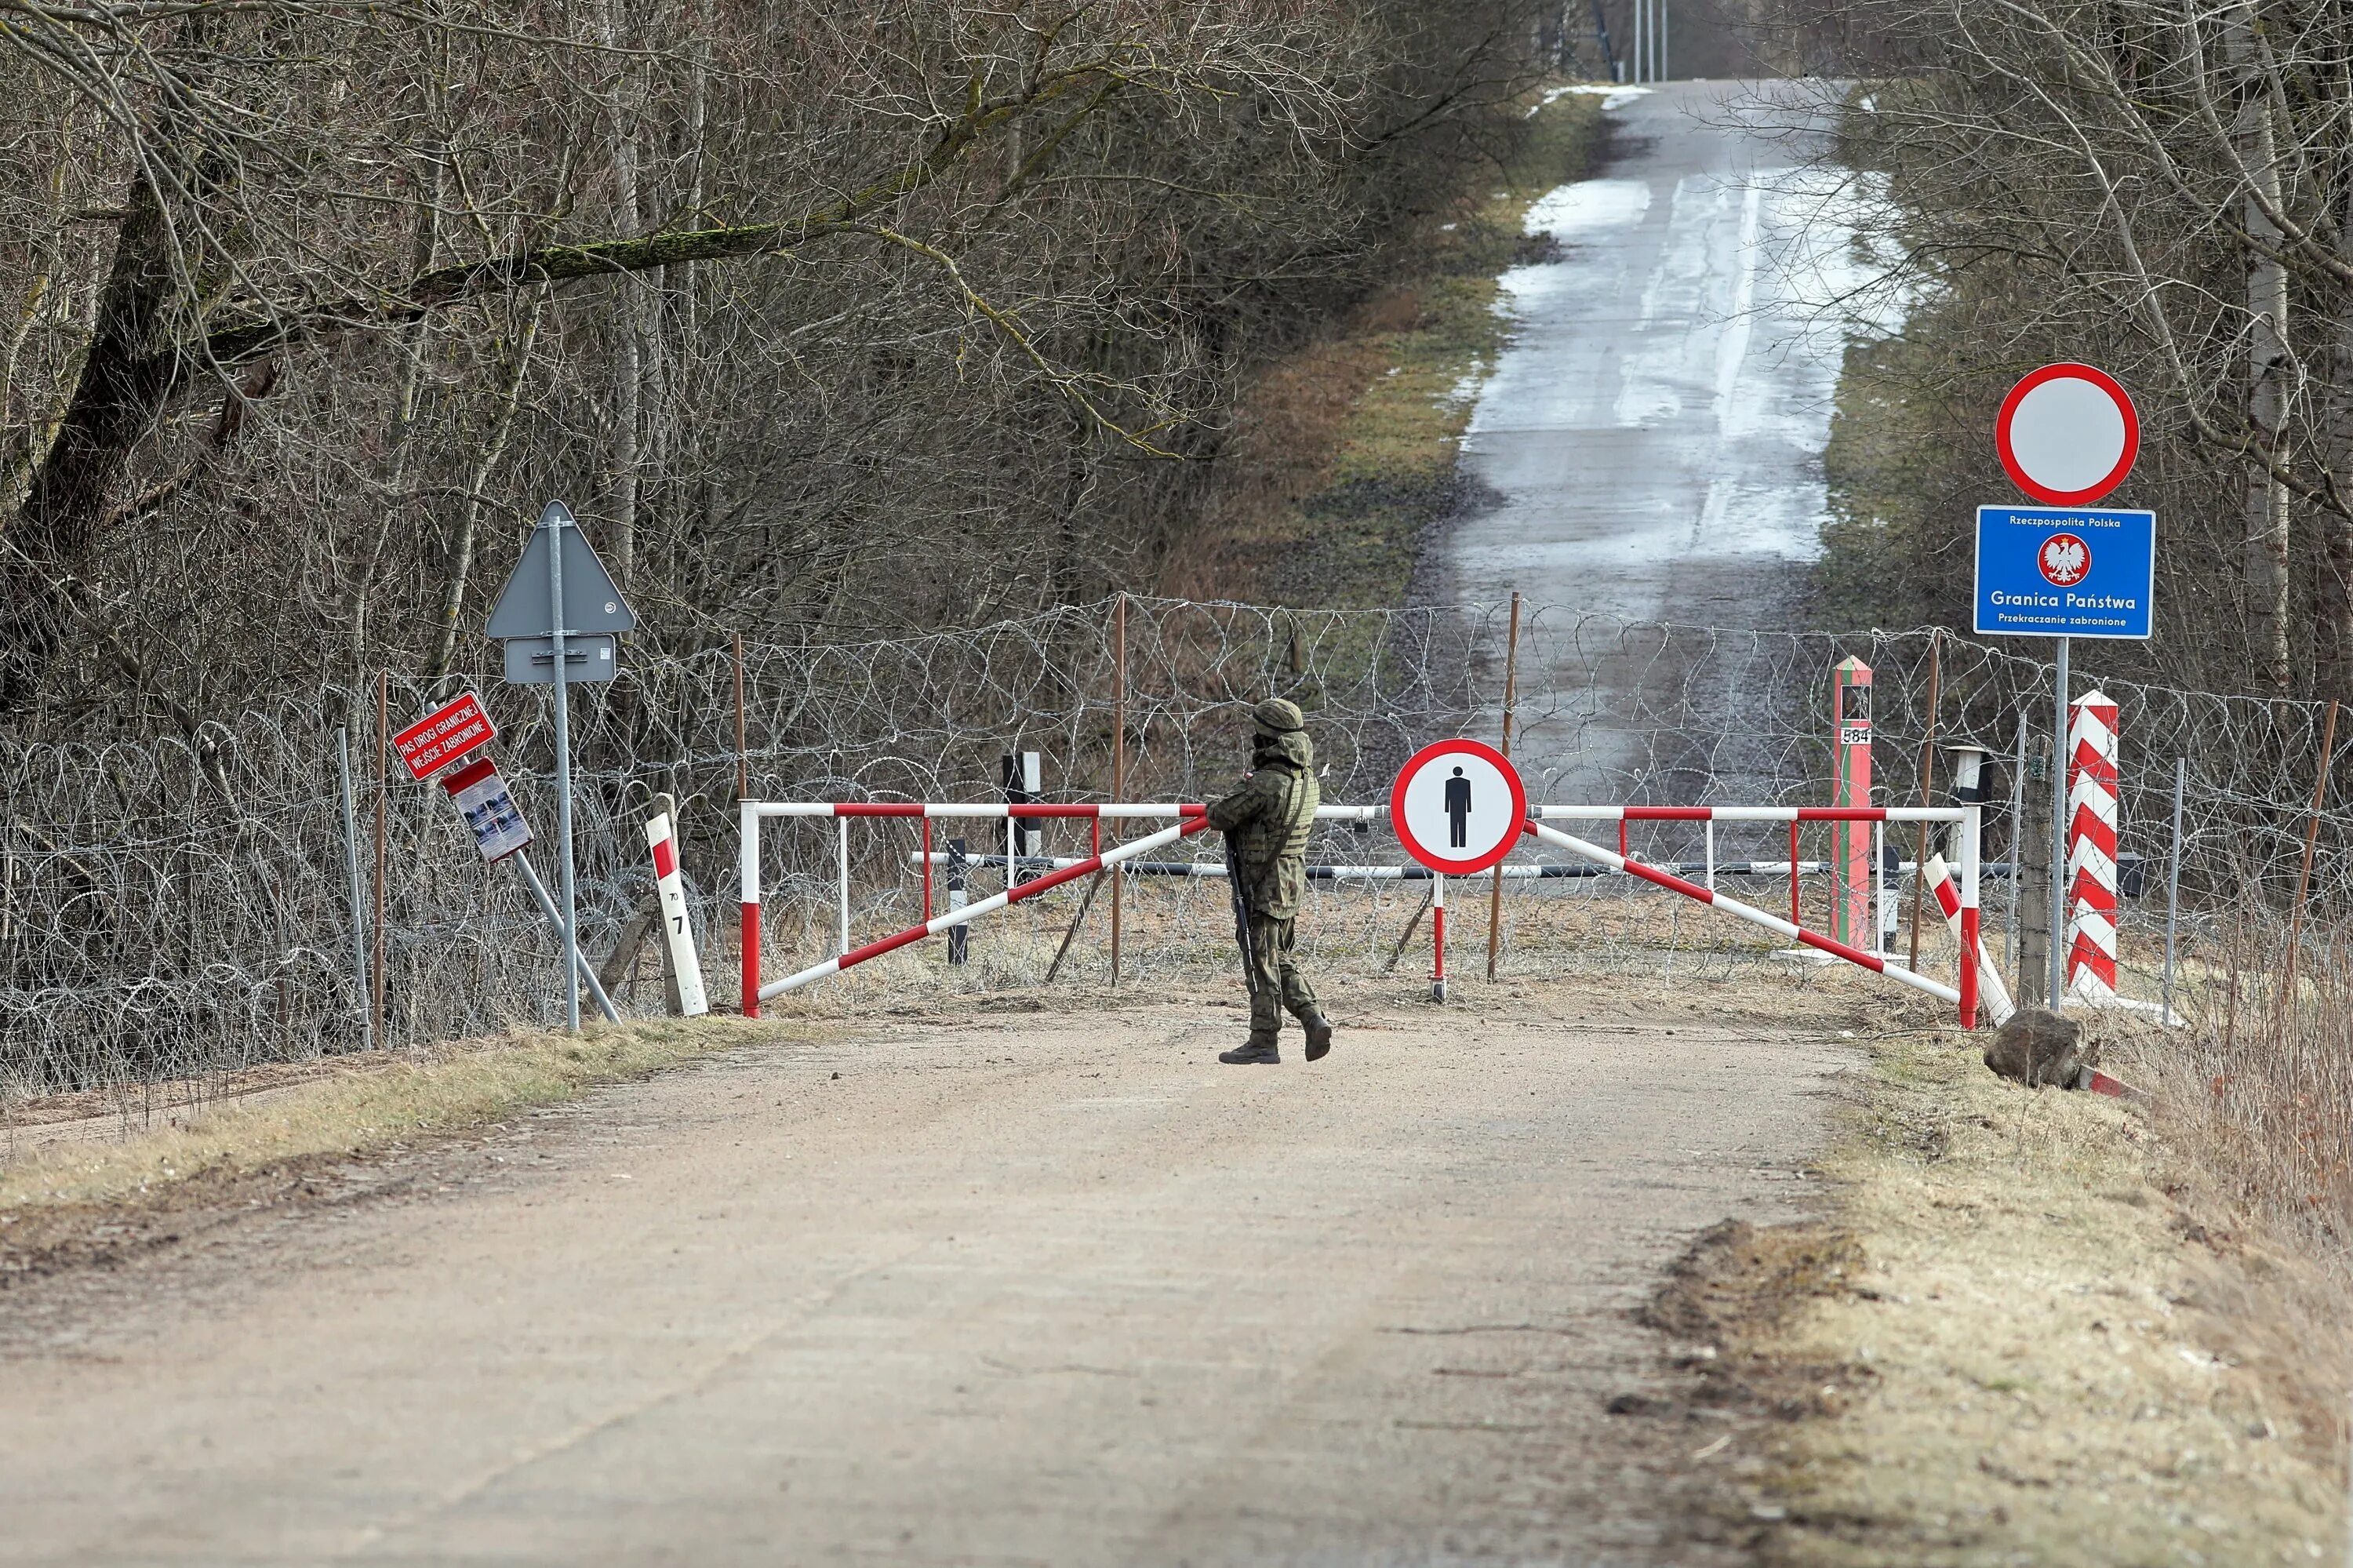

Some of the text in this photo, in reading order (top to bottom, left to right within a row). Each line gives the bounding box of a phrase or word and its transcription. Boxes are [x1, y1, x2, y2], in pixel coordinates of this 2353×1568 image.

[2010, 516, 2121, 529] Rzeczpospolita Polska
[1991, 591, 2136, 609] Granica Państwa
[1998, 613, 2126, 627] Przekraczanie zabronione
[400, 704, 478, 756] PAS DROGI GRANICZNEJ
[1844, 729, 1868, 742] 584
[411, 720, 486, 770] WEJŚCIE ZABRONIONE
[669, 893, 678, 901] 70
[672, 915, 683, 934] 7
